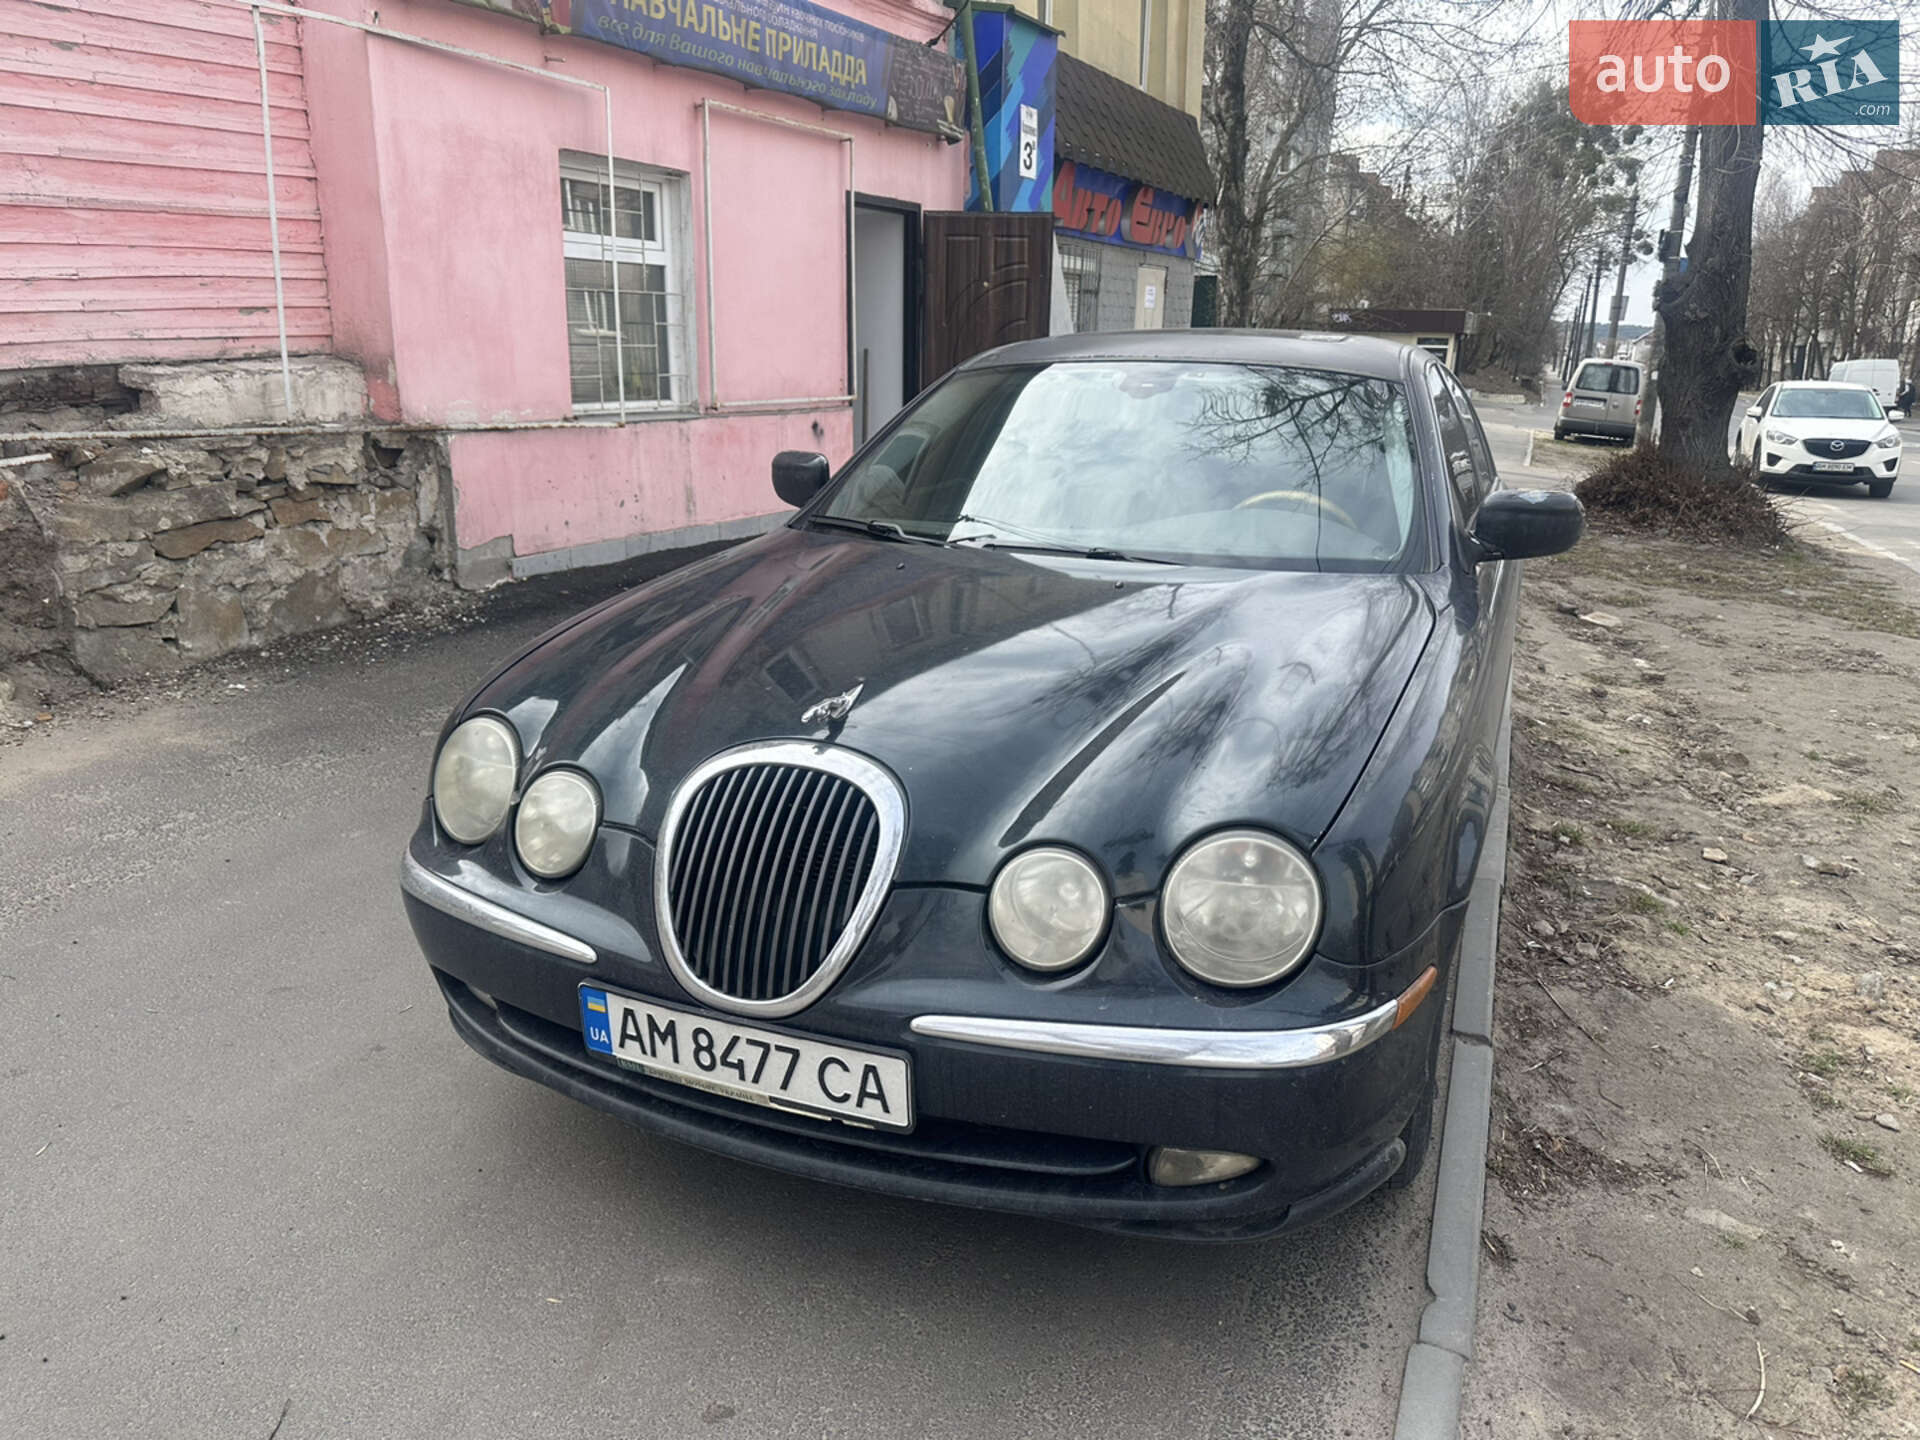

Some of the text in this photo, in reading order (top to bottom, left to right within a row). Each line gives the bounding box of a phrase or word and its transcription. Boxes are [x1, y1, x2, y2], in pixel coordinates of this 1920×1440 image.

[597, 15, 629, 36] все
[631, 22, 666, 46] для
[668, 33, 735, 67] Вашого
[737, 59, 826, 94] навчального
[765, 27, 868, 89] ПРИЛАДДЯ
[590, 1026, 609, 1044] UA
[618, 1007, 891, 1114] AM 8477 CA
